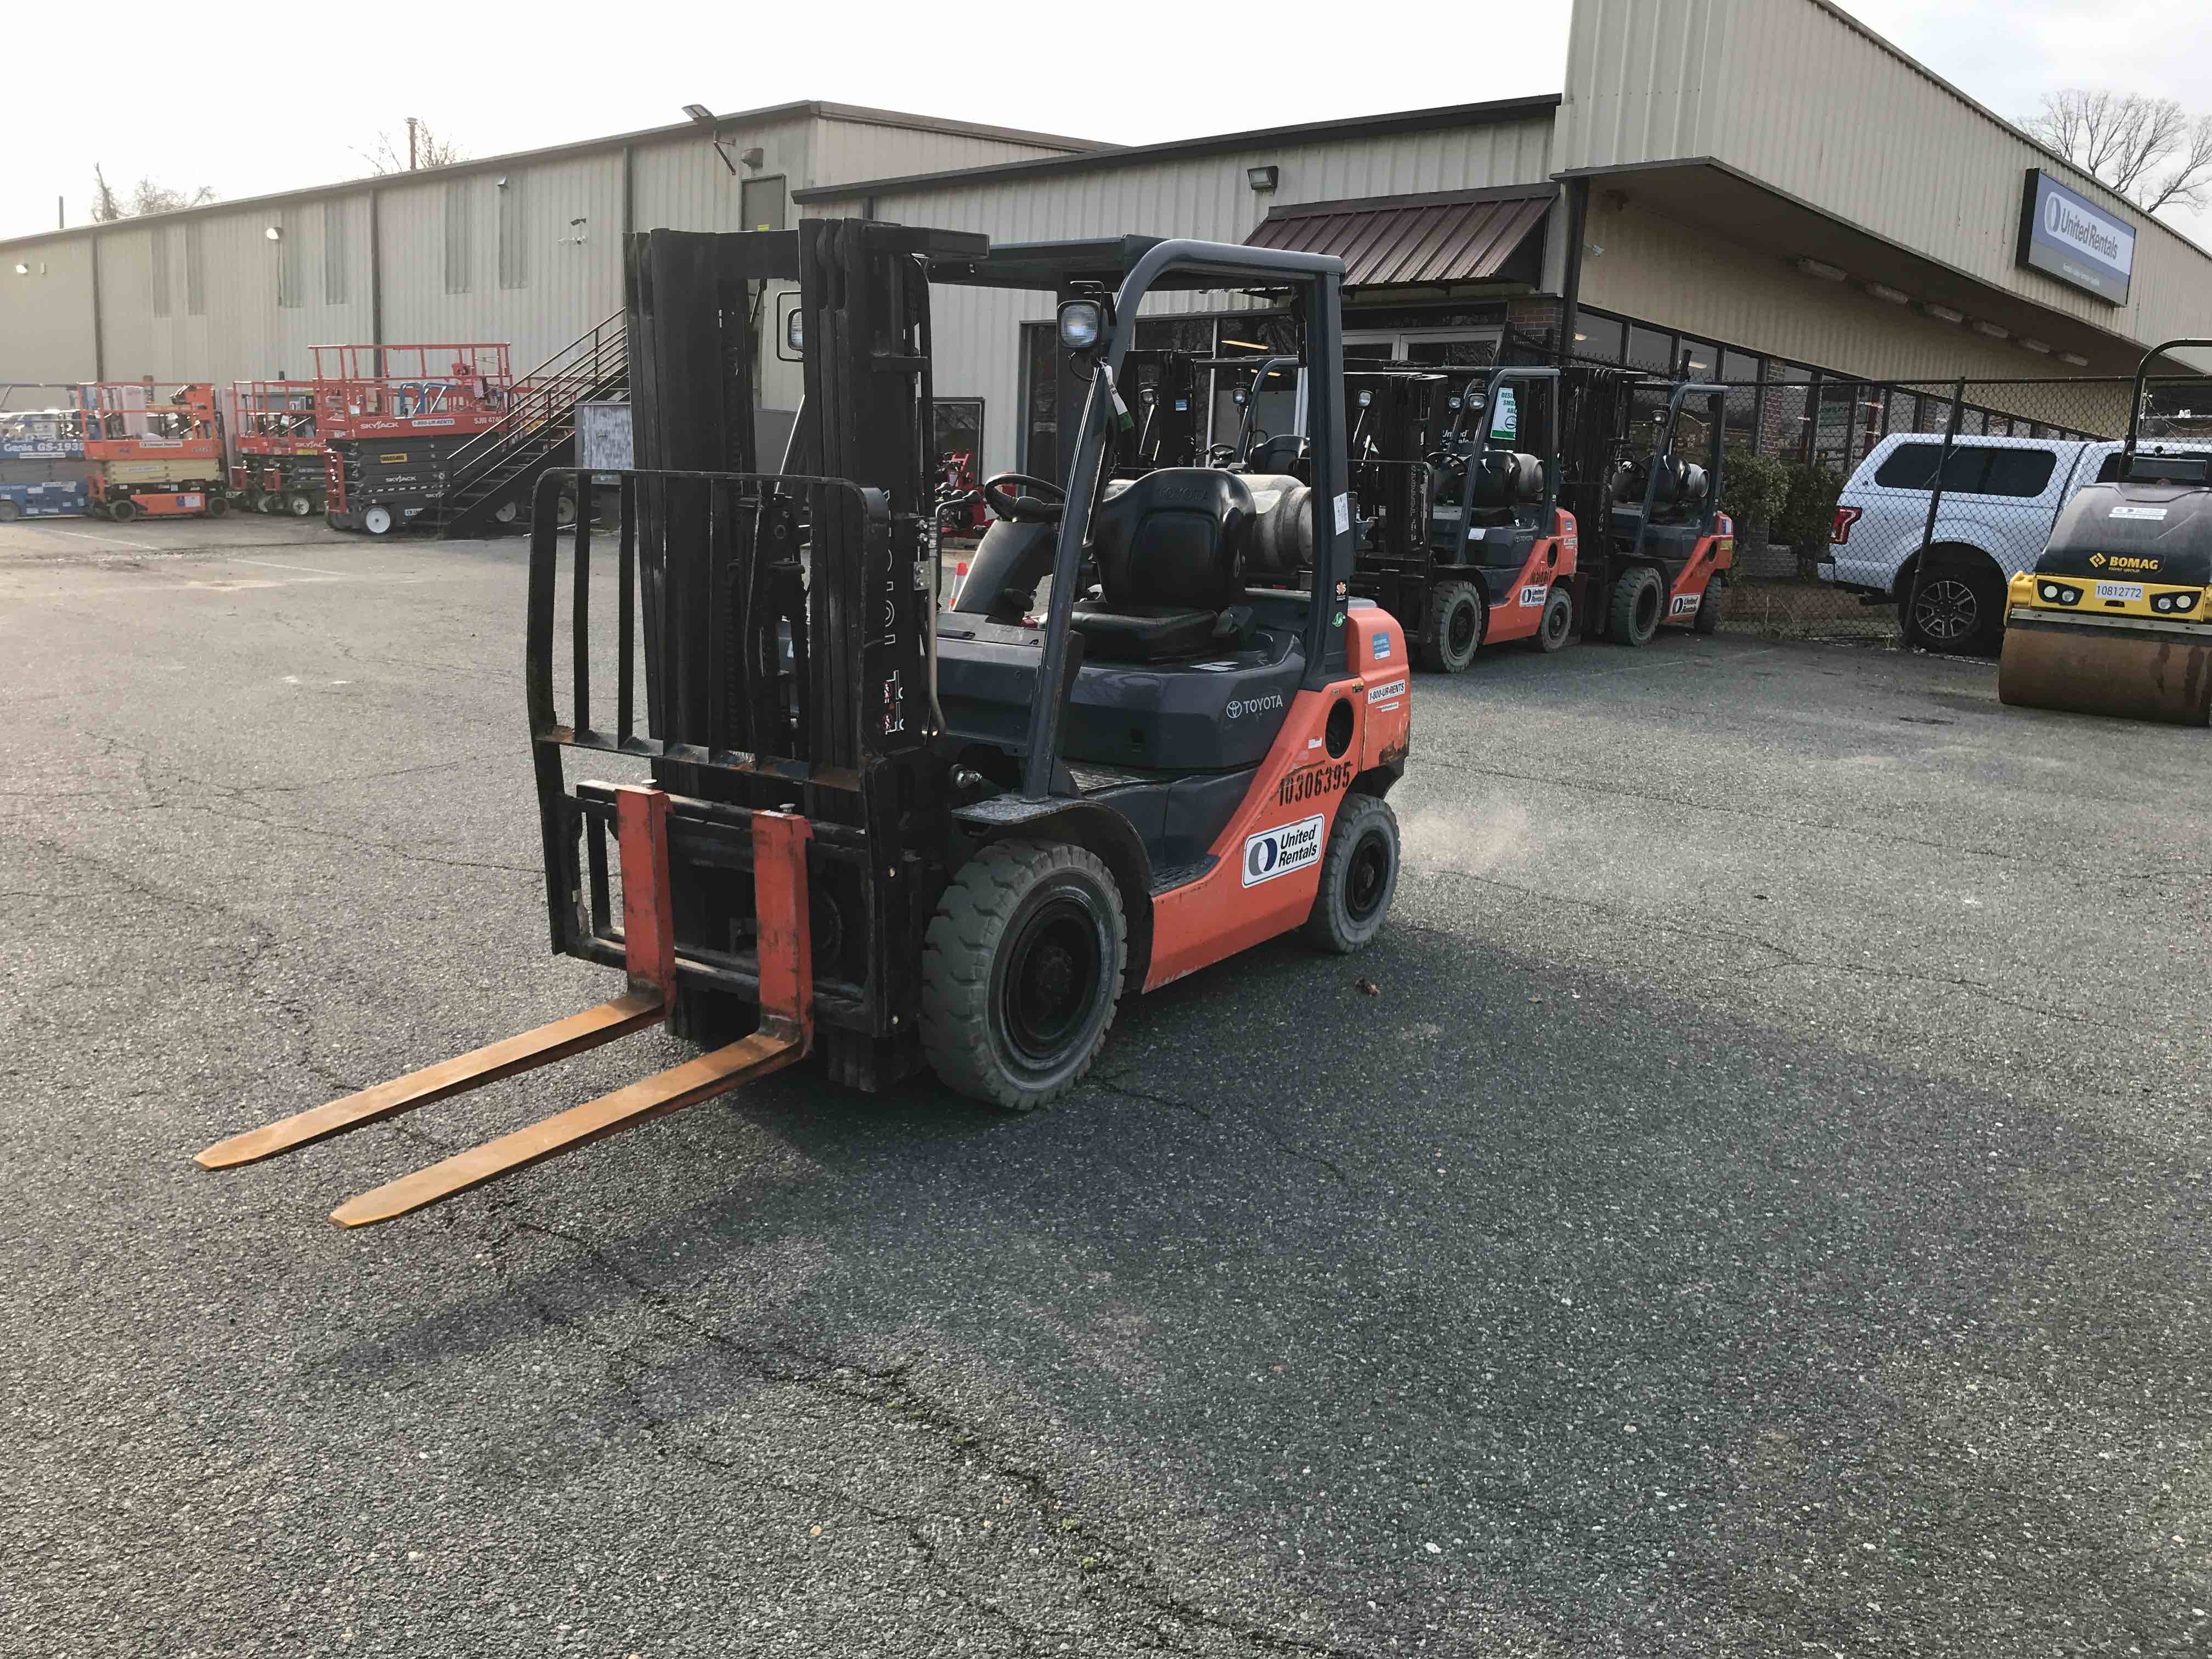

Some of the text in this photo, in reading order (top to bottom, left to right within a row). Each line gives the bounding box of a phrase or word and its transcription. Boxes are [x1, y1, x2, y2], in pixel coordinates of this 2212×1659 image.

[2061, 207, 2118, 260] United Rentals
[360, 420, 400, 430] SKYJACK
[4, 443, 33, 452] Genie
[2109, 556, 2159, 571] BOMAG
[2097, 585, 2141, 598] 10812772
[1243, 694, 1283, 714] TOYOTA
[1278, 760, 1353, 806] 10306395
[1280, 824, 1317, 850] United
[1278, 842, 1317, 868] Rentals
